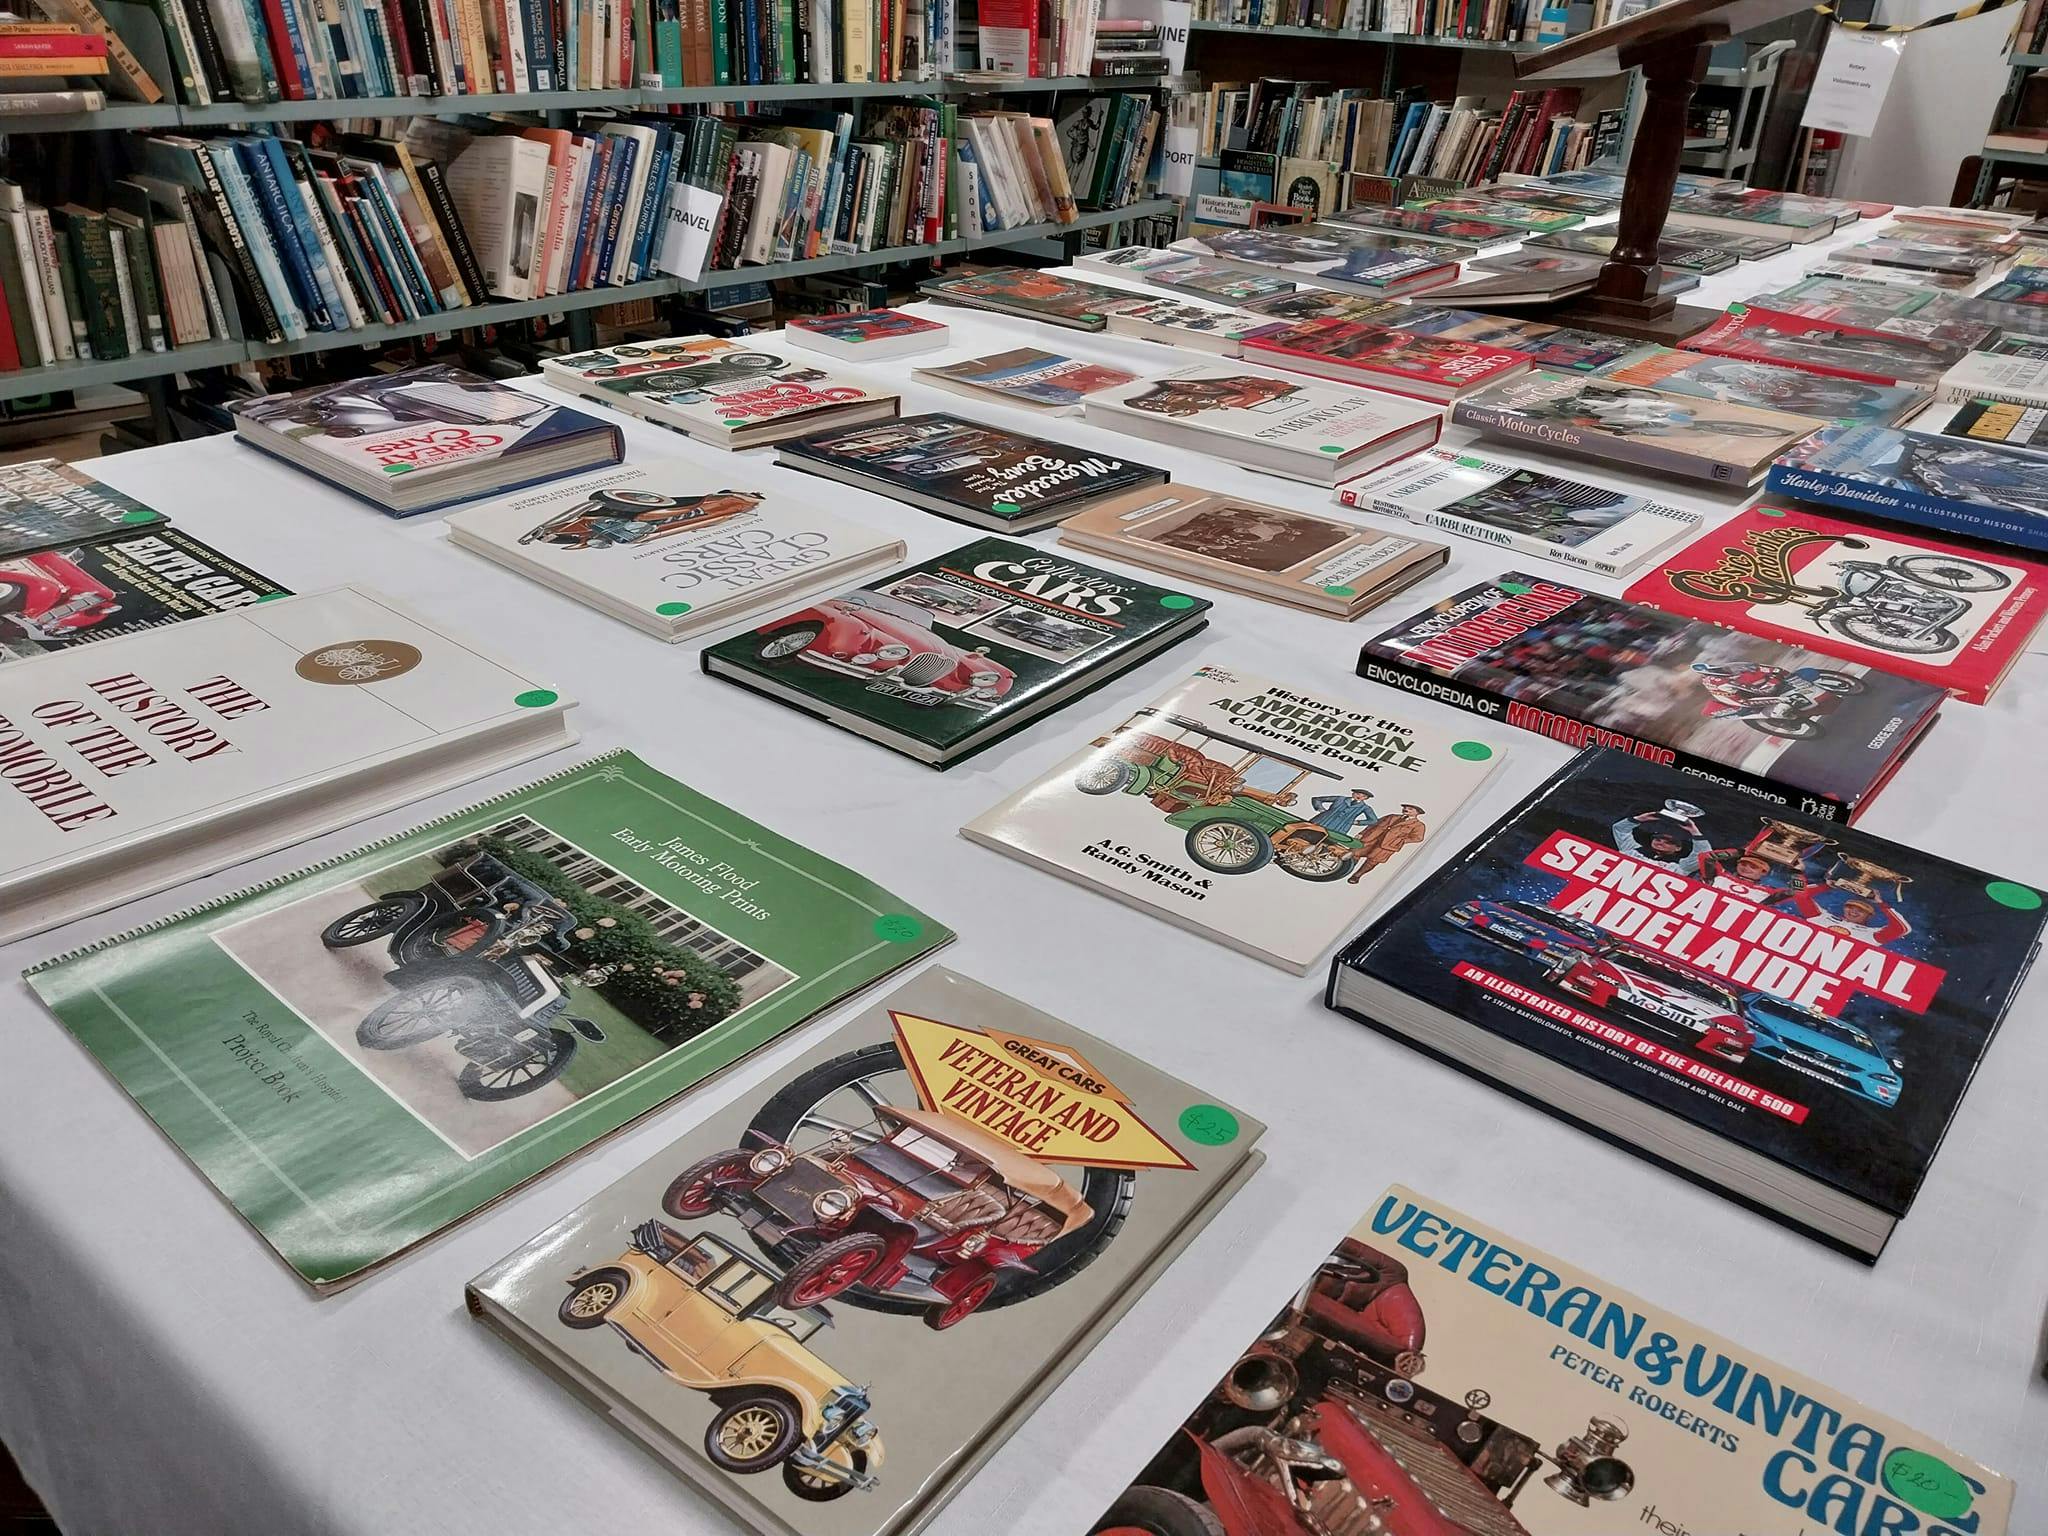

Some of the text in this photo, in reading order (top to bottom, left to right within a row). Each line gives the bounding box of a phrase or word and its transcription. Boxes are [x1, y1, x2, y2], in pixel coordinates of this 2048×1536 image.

[537, 35, 547, 60] SITES
[556, 39, 567, 87] AUSTRALIA
[1114, 66, 1134, 75] wine
[545, 167, 557, 209] IRELAND
[849, 149, 859, 178] Perform
[196, 148, 245, 249] LAND OF THE SCOTS
[257, 153, 294, 233] ANTARCTICA
[554, 154, 577, 251] Explore Australia
[583, 179, 598, 239] KIMBERLEY
[607, 141, 636, 241] Explore Australia Caravan
[637, 149, 664, 242] TIMELESS JOURNEYS
[1202, 198, 1247, 211] Historic Places
[1212, 206, 1241, 217] Australia
[432, 177, 486, 299] ILLUSTRATED GUIDE TO BRITAIN
[667, 206, 710, 232] TRAVEL
[1452, 355, 1512, 377] CLASSIC
[1951, 386, 1973, 398] THE
[365, 428, 471, 454] CARS
[378, 434, 504, 467] GREAT
[1466, 409, 1581, 446] Classic Motor Cycles
[986, 454, 1066, 480] Benz
[992, 456, 1124, 506] Mercedes
[1342, 490, 1356, 506] 5
[1372, 505, 1410, 520] MOTORCYCLES
[1373, 499, 1404, 512] RESTORING
[1781, 472, 2025, 532] Harley-Davidson AN ILLUSTRATED HISTORY
[632, 545, 669, 560] HARVEY
[662, 528, 775, 567] CARS
[693, 531, 713, 540] AND
[1425, 513, 1512, 545] CARBURETTORS
[112, 536, 215, 582] ELITE
[660, 531, 829, 590] CLASSIC
[719, 547, 831, 591] GREAT
[1549, 548, 1562, 560] Roy
[1563, 552, 1588, 566] Bacon
[1667, 548, 1755, 603] Classic
[184, 575, 261, 611] CAR
[943, 573, 1001, 597] GENERATION
[1000, 592, 1018, 602] OF
[1016, 597, 1066, 619] POST-WAR
[1065, 612, 1114, 633] CLASSICS
[973, 560, 1134, 616] CARS
[1410, 587, 1504, 639] ENCYCLOPEDIA OF
[1401, 583, 1587, 671] MOTORCYCLING
[86, 671, 244, 763] HISTORY
[184, 675, 272, 721] THE
[1267, 686, 1414, 737] History of the
[31, 700, 158, 778] OF THE
[1209, 699, 1428, 774] AUTOMOBILE
[1228, 716, 1384, 773] Coloring Book
[1246, 695, 1415, 753] AMERICAN
[1367, 664, 1474, 710] ENCYCLOPEDIA
[1477, 698, 1500, 715] OF
[1681, 766, 1735, 789] GEORGE
[1738, 784, 1787, 805] BISHOP
[1867, 728, 1891, 750] GEORGE
[610, 826, 771, 922] Early Motoring Prints
[658, 835, 760, 891] James Flood
[1081, 844, 1208, 902] Randy Mason
[1097, 838, 1215, 891] A.G. Smith &
[1489, 923, 1525, 940] BOSCH
[1539, 838, 1920, 1003] SENSATIONAL
[1562, 887, 1846, 1014] ADELAIDE
[1597, 972, 1619, 987] NGK
[241, 1010, 258, 1026] The
[1463, 968, 1482, 983] AN
[1484, 975, 1571, 1024] ILLUSTRATED
[1571, 1010, 1634, 1047] HISTORY
[1636, 1039, 1657, 1056] OF
[1656, 1046, 1688, 1070] THE
[1688, 1057, 1759, 1102] ADELAIDE
[1759, 1094, 1795, 1117] 500
[1715, 1023, 1740, 1036] NGK
[222, 1033, 300, 1104] Project Book
[1004, 1040, 1107, 1096] GREAT CARS
[1482, 993, 1493, 1001] BY
[1492, 997, 1515, 1013] STEFAN
[1515, 1007, 1575, 1039] BARTHOLOMAEUS,
[1574, 1033, 1606, 1054] RICHARD
[1632, 1059, 1658, 1076] AARON
[1658, 1070, 1689, 1089] NOONAN
[1689, 1083, 1707, 1097] AND
[1707, 1090, 1727, 1106] WILL
[1727, 1100, 1746, 1114] DALE
[938, 1038, 1121, 1143] VETERAN AND
[940, 1077, 1062, 1154] VINTAGE
[1186, 1114, 1233, 1142] $25
[1549, 1343, 1741, 1455] PETER ROBERTS
[1762, 1450, 1958, 1536] CAR
